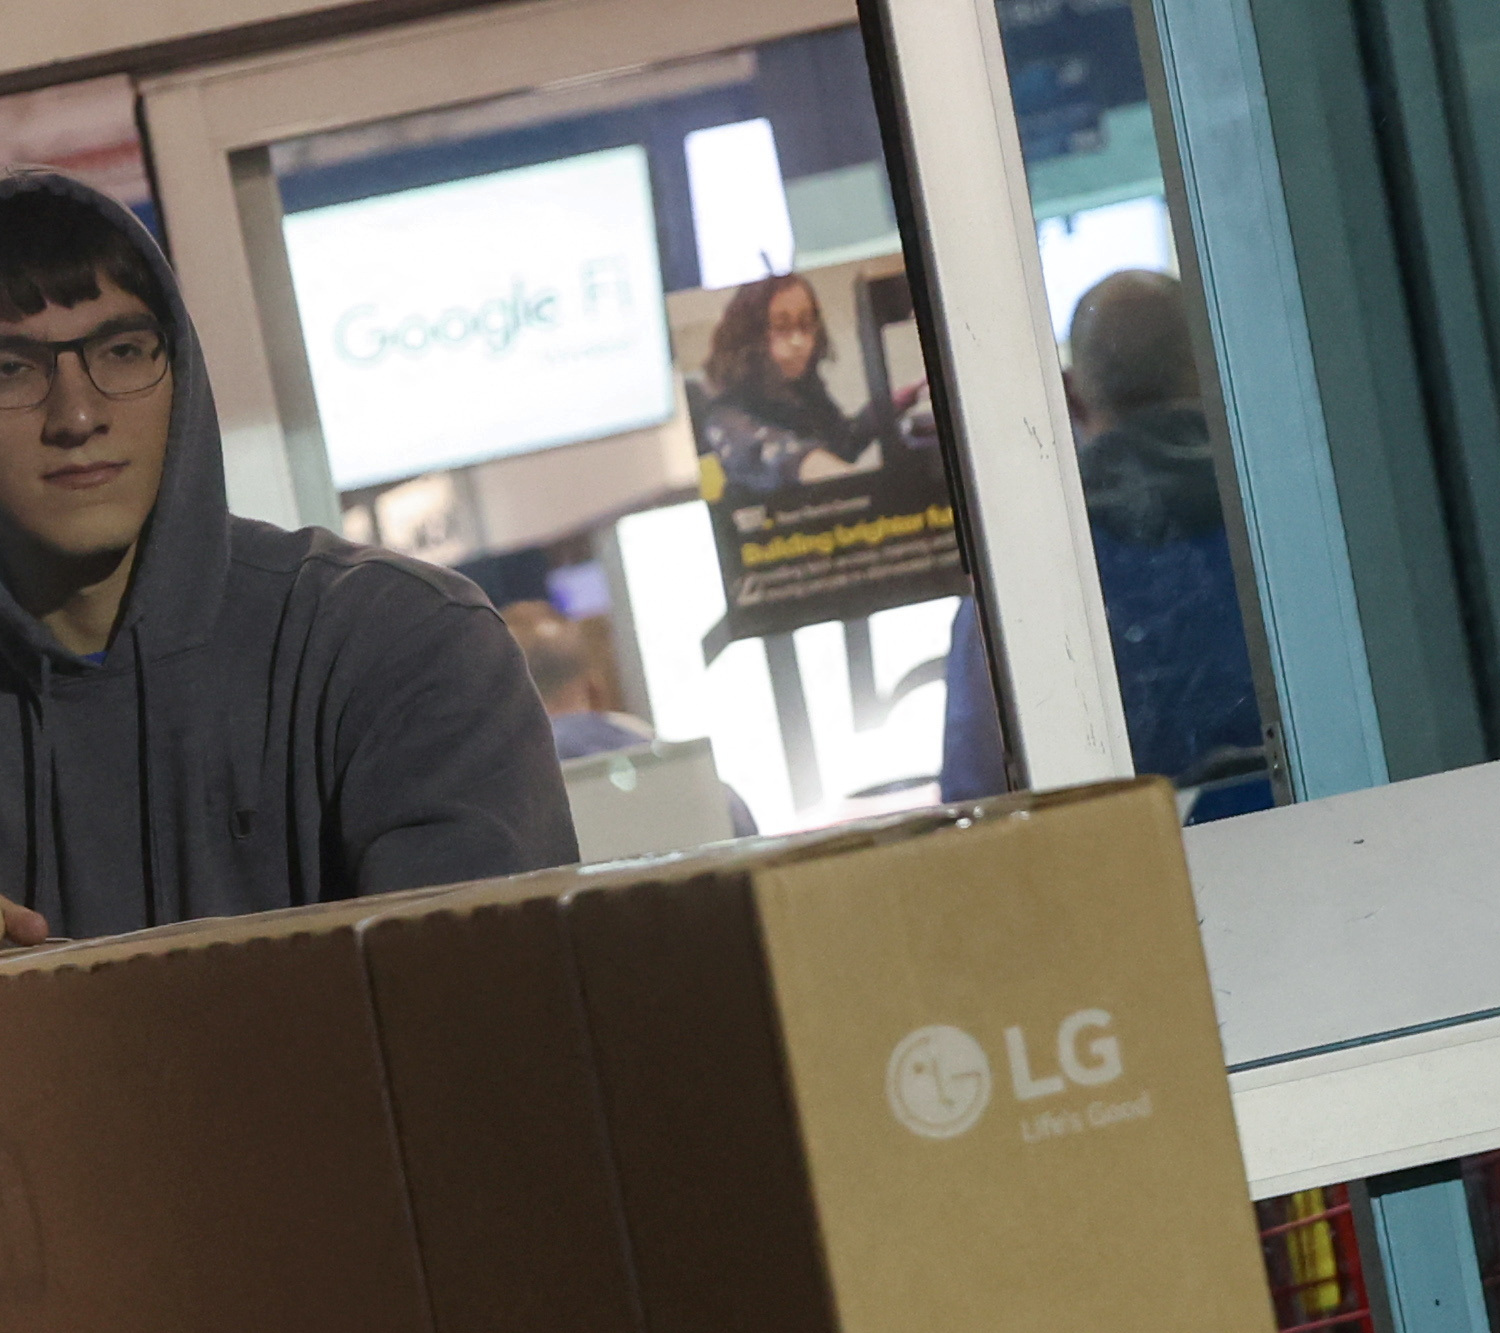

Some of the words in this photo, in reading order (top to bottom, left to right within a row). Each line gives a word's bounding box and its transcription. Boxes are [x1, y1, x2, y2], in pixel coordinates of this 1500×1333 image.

[335, 277, 563, 373] Google
[741, 532, 834, 567] Building
[834, 514, 926, 544] brighter
[1004, 1008, 1124, 1103] LG
